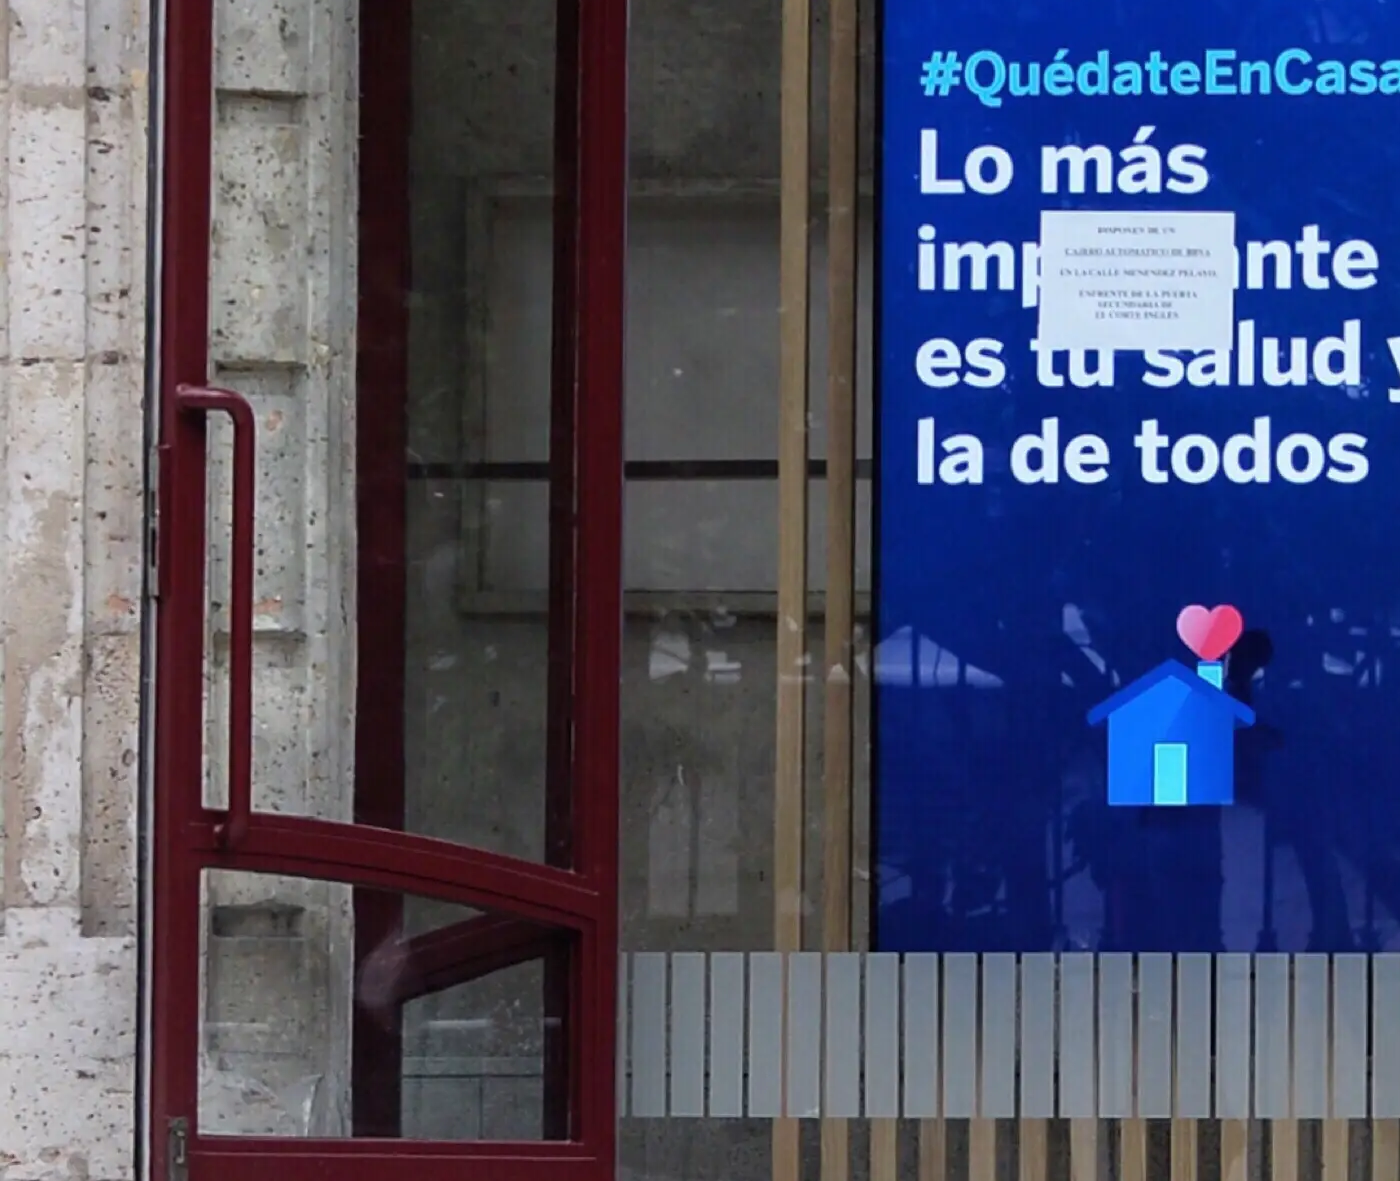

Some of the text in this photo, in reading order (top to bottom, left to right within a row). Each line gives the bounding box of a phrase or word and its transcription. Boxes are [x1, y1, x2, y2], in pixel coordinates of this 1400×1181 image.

[919, 125, 1209, 194] Lo más
[1147, 226, 1159, 234] DE
[1171, 248, 1184, 257] DE
[1131, 290, 1143, 298] DE
[916, 337, 1006, 389] es
[1030, 337, 1115, 388] tu
[1143, 319, 1361, 388] salud
[917, 415, 1370, 485] la de todos
